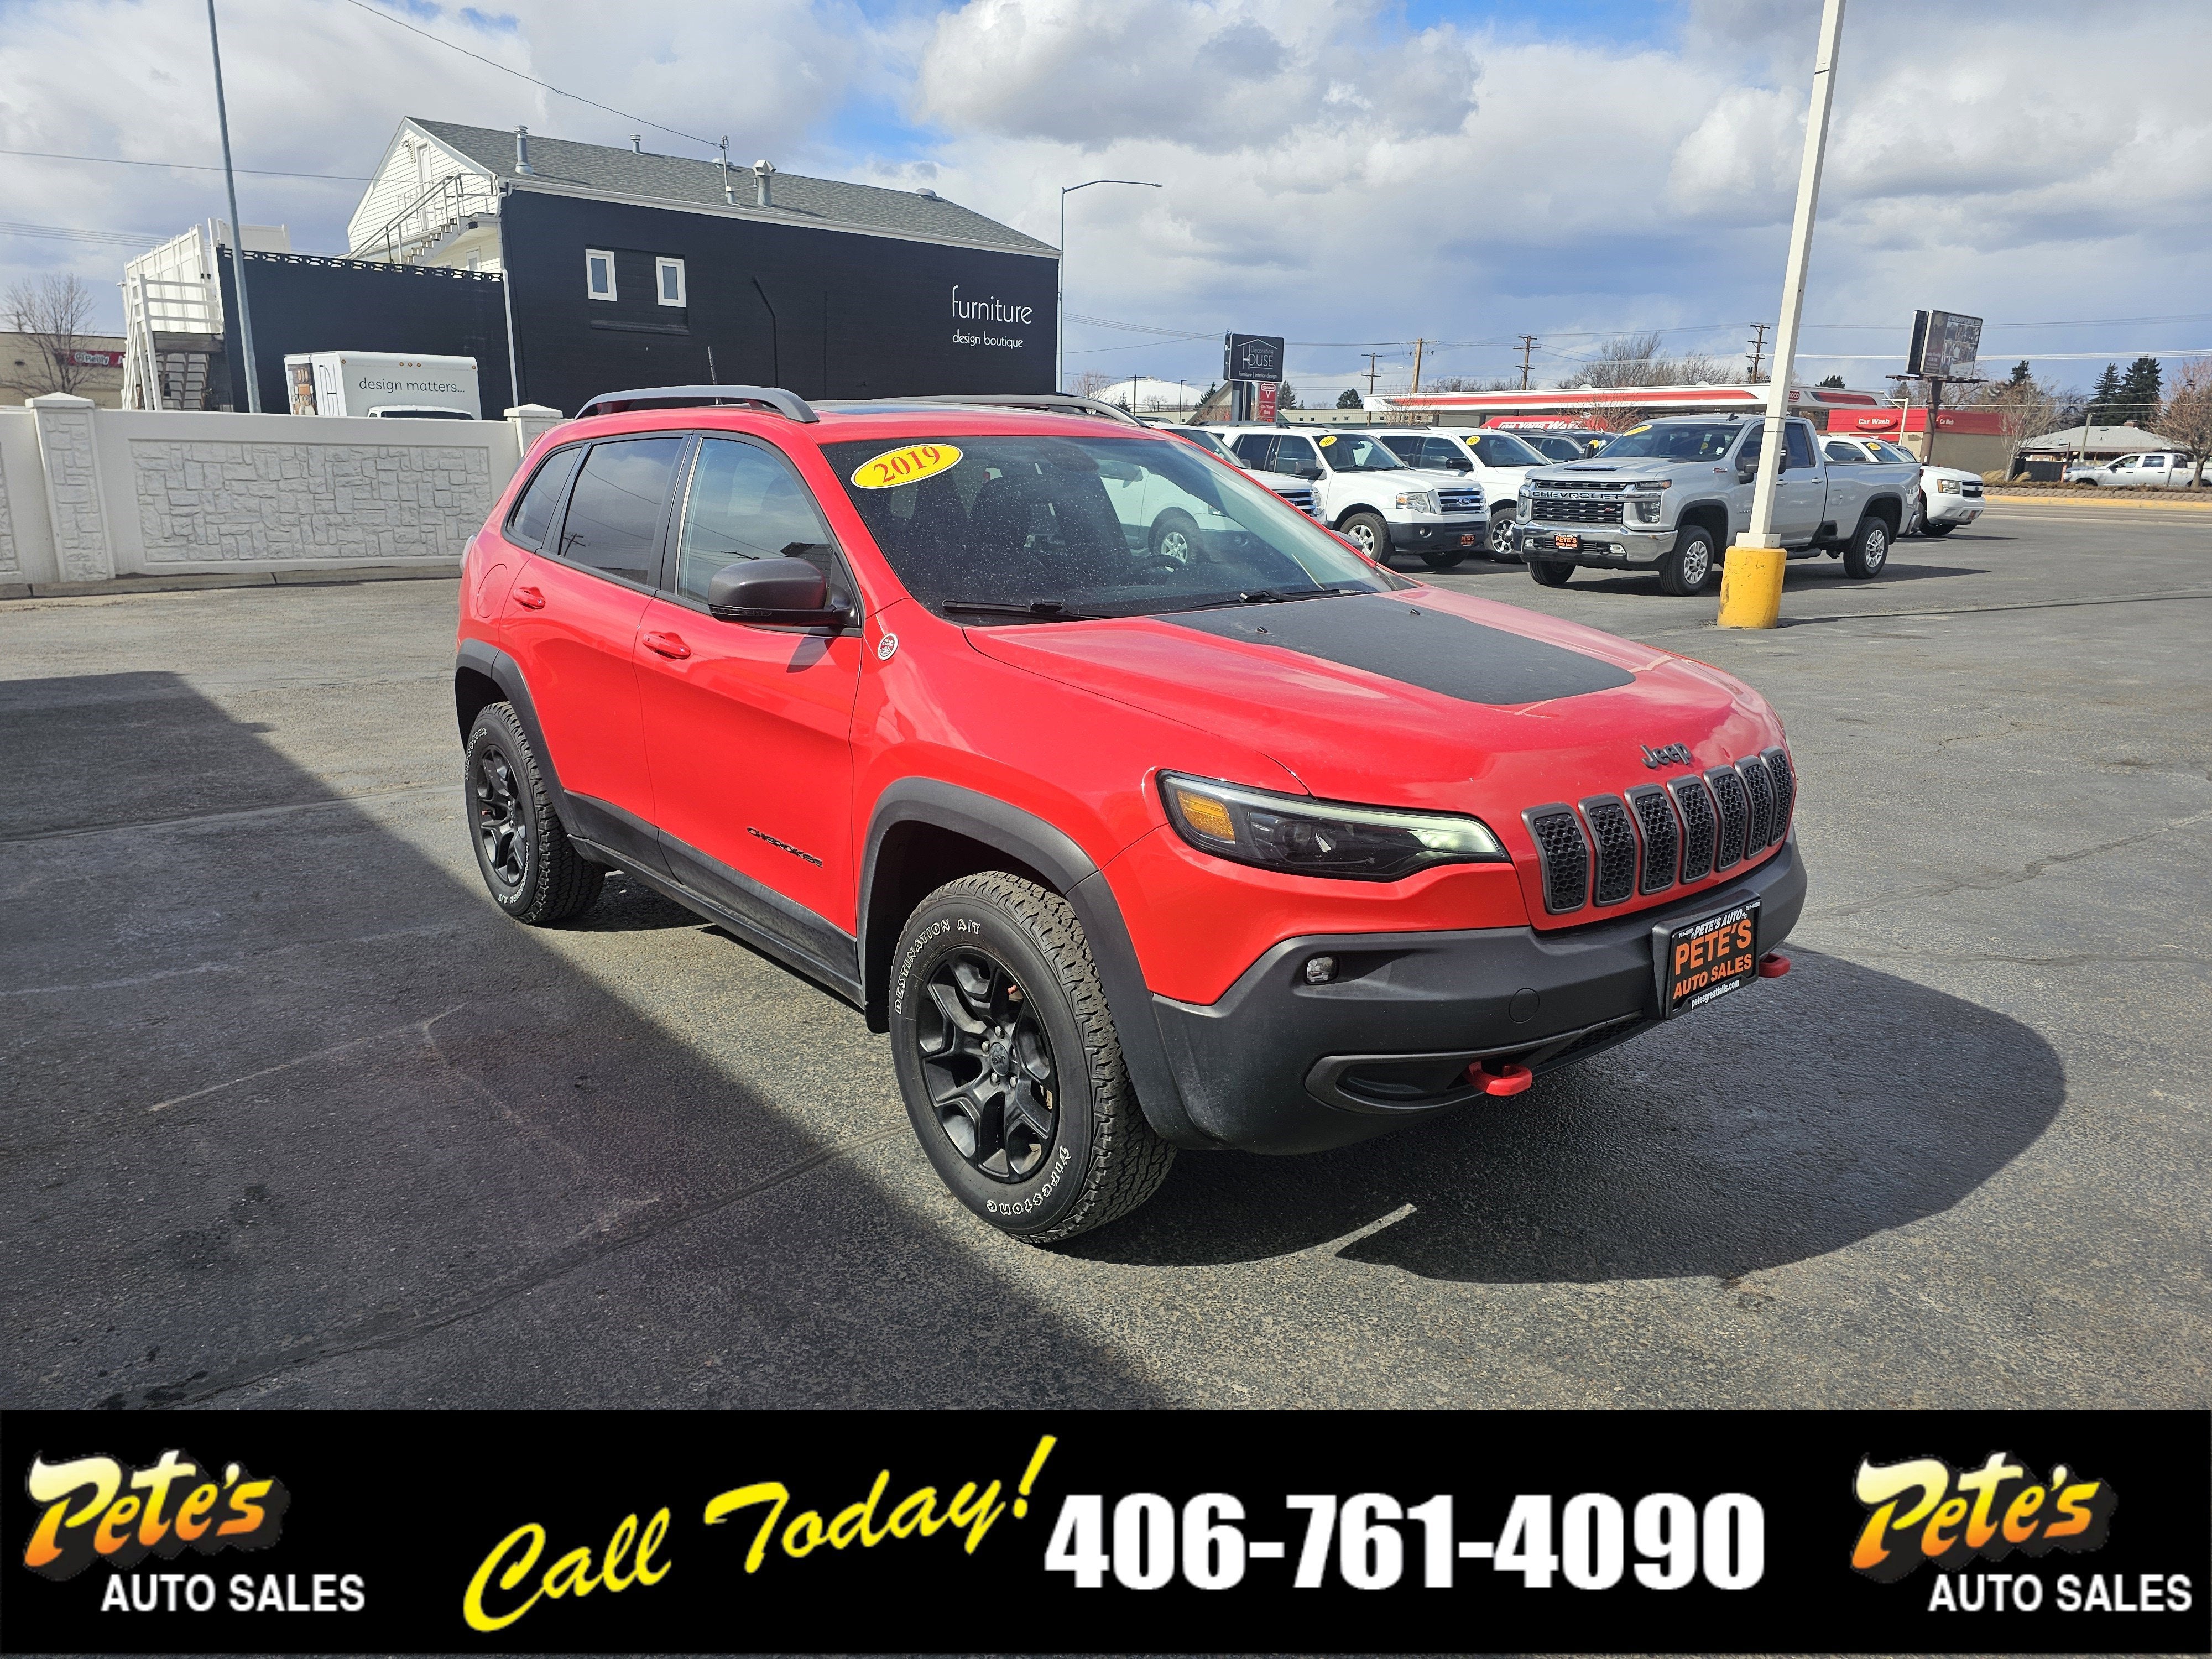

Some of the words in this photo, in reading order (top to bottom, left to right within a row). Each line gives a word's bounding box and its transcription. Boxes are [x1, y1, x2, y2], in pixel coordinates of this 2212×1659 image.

[952, 285, 1033, 324] furniture
[952, 328, 980, 347] design
[984, 331, 1024, 349] boutique
[1250, 345, 1274, 355] Decorating
[359, 377, 402, 393] design
[406, 380, 465, 393] matters...
[873, 446, 940, 483] 2019
[1532, 491, 1623, 499] CHEVROLET
[1640, 742, 1692, 769] Jeep
[747, 827, 823, 869] CHEROKEE
[1695, 916, 1721, 937] PETE'S
[1721, 908, 1743, 927] AUTO
[1675, 919, 1752, 975] PETE'S
[894, 918, 950, 1015] DESTINATION
[957, 918, 980, 935] A/T
[1673, 971, 1708, 999] AUTO
[1710, 953, 1752, 982] SALES
[1691, 979, 1740, 1010] petesgreatfalls.com
